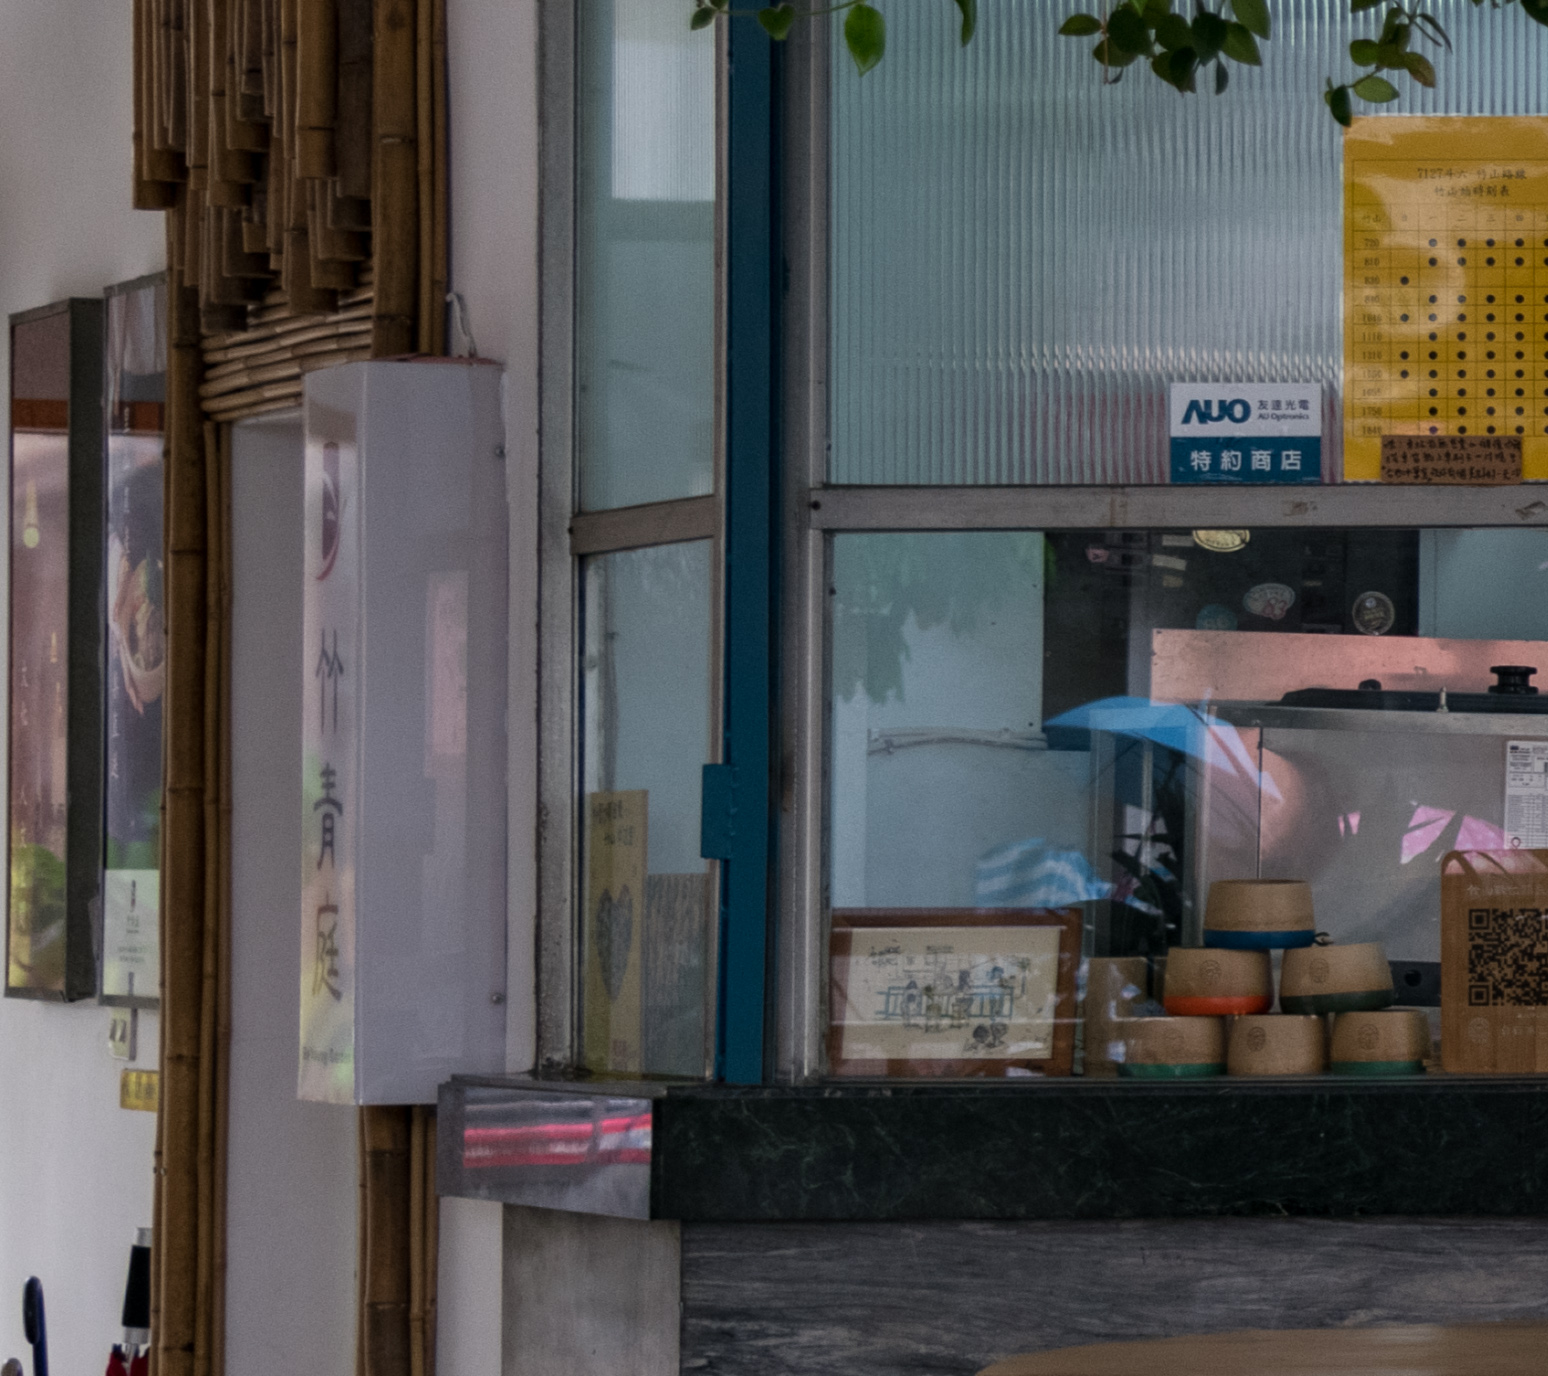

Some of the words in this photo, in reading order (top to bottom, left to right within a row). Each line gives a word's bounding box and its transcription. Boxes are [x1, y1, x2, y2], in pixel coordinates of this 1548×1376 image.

[1181, 398, 1252, 425] AUO
[1190, 449, 1302, 472] 特約商店
